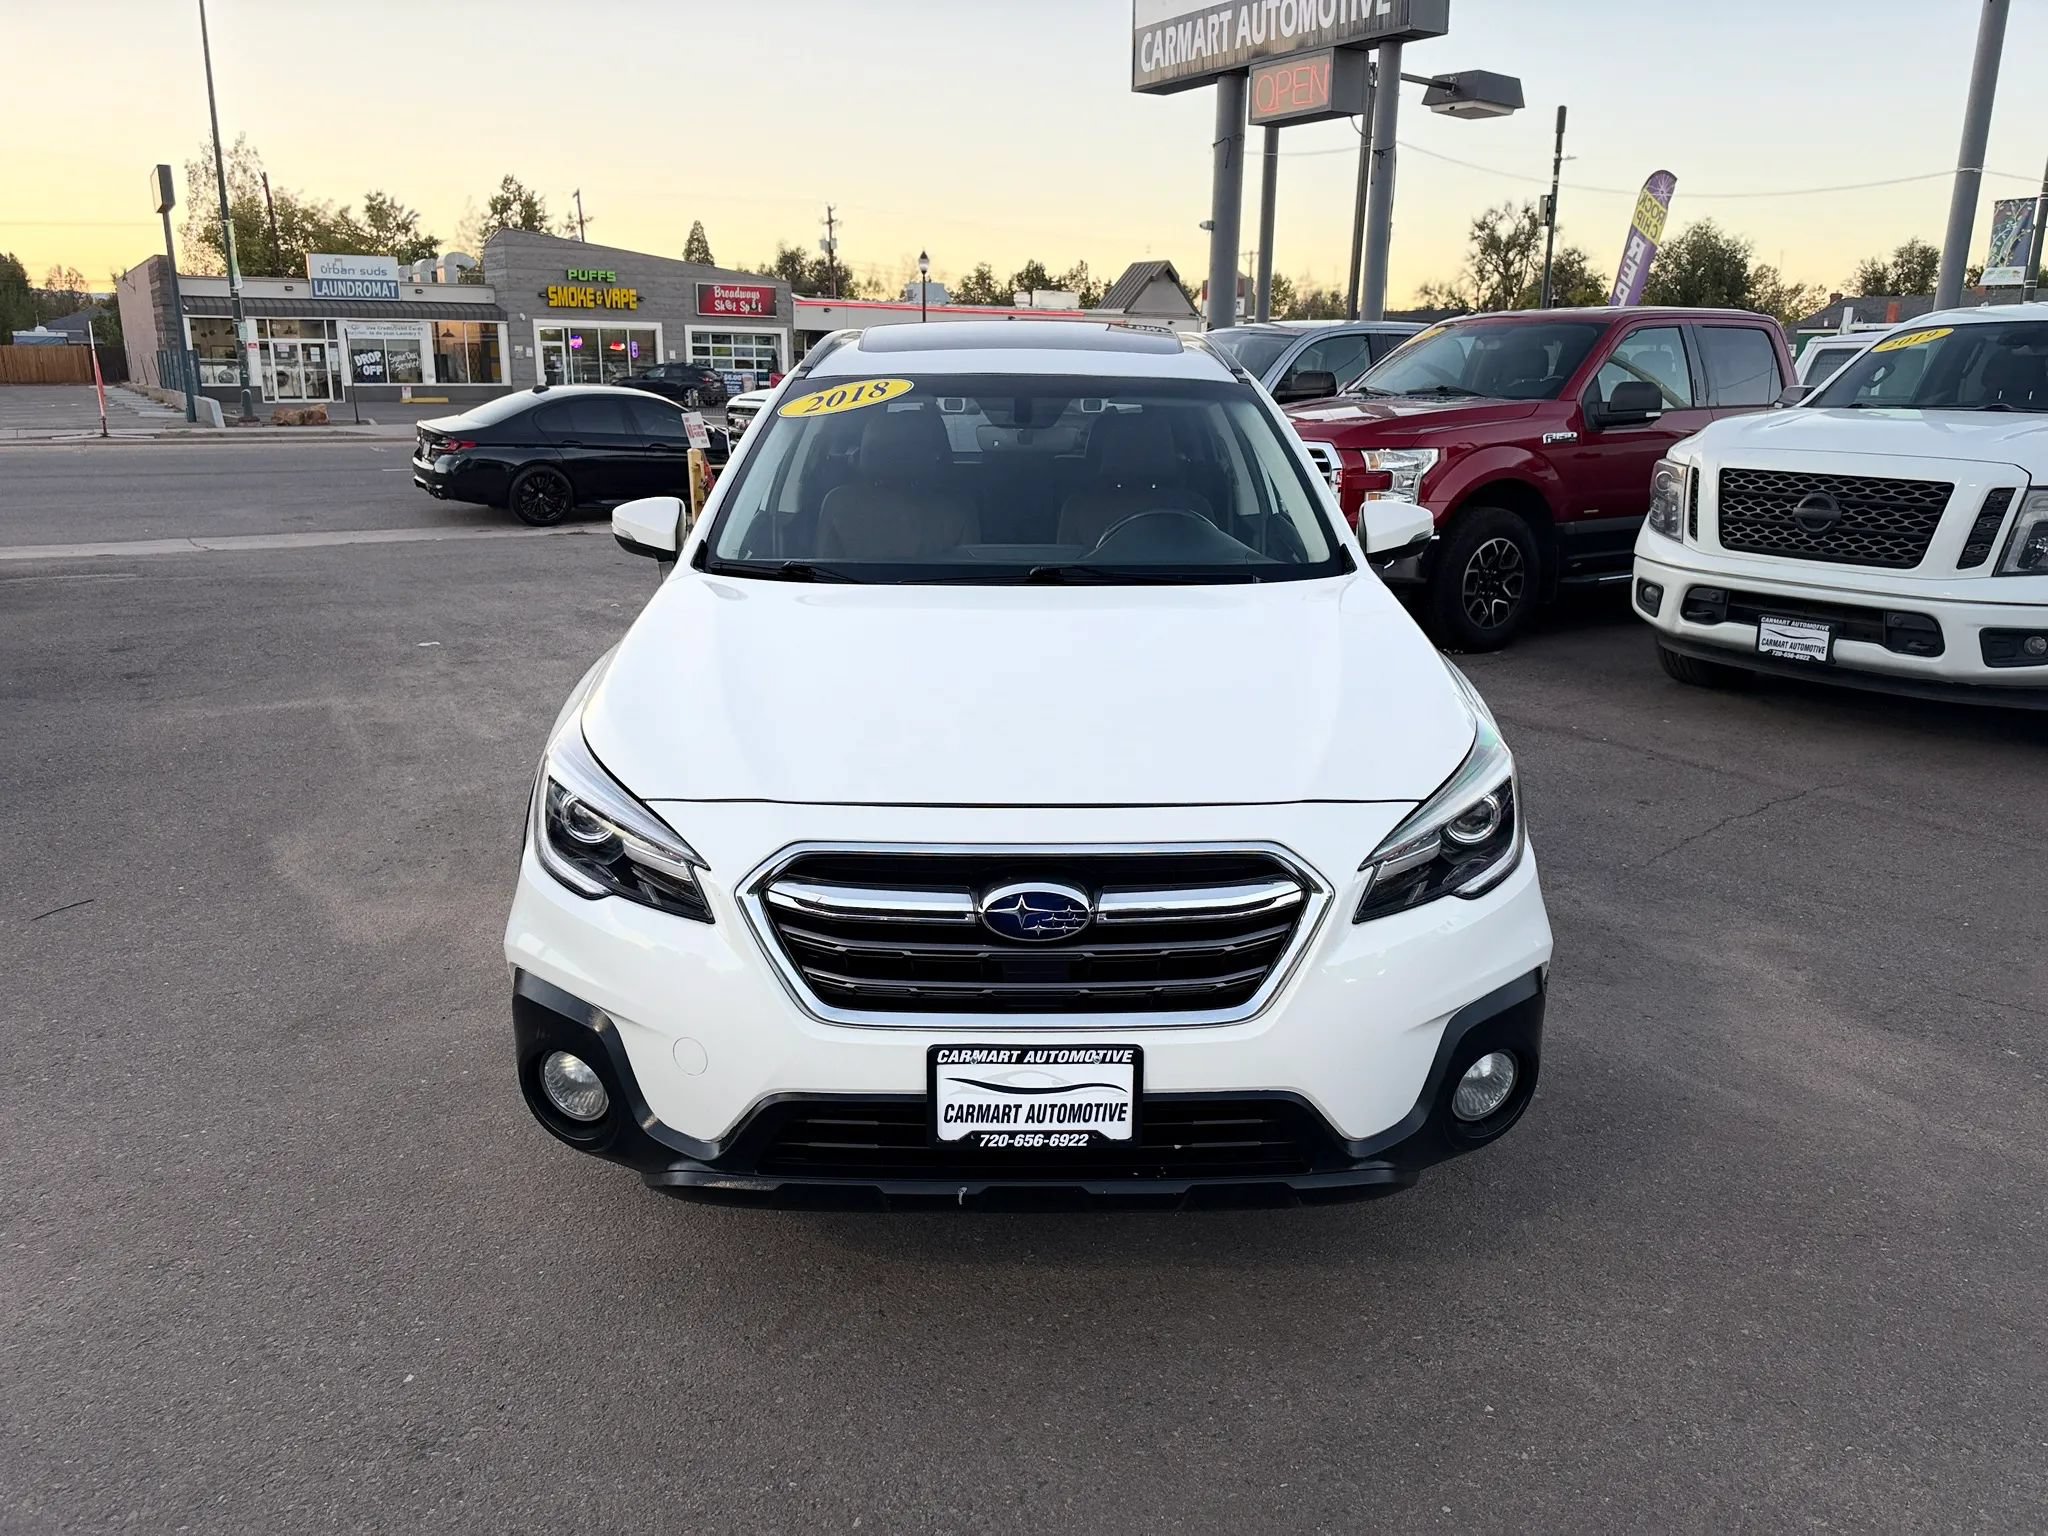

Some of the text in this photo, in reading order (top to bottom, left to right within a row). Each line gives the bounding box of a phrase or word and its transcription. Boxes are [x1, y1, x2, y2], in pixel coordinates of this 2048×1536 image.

[1141, 10, 1232, 73] CARMART
[1256, 64, 1330, 112] OPEN
[321, 261, 388, 276] urban suds
[567, 269, 617, 282] PUFFS
[314, 280, 396, 297] LAUNDROMAT
[713, 286, 761, 299] Broadways
[547, 285, 638, 310] SMOKE & VAPE
[354, 351, 381, 366] DROP
[363, 365, 383, 375] OFF
[803, 381, 890, 413] 2018
[1761, 617, 1830, 631] CARMART AUTOMOTIVE
[1761, 638, 1826, 654] CARMART AUTOMOTIVE
[937, 1050, 1133, 1063] CARMART AUTOMOTIVE
[944, 1103, 1128, 1123] CARMART AUTOMOTIVE
[979, 1134, 1089, 1147] 720-656-6922
